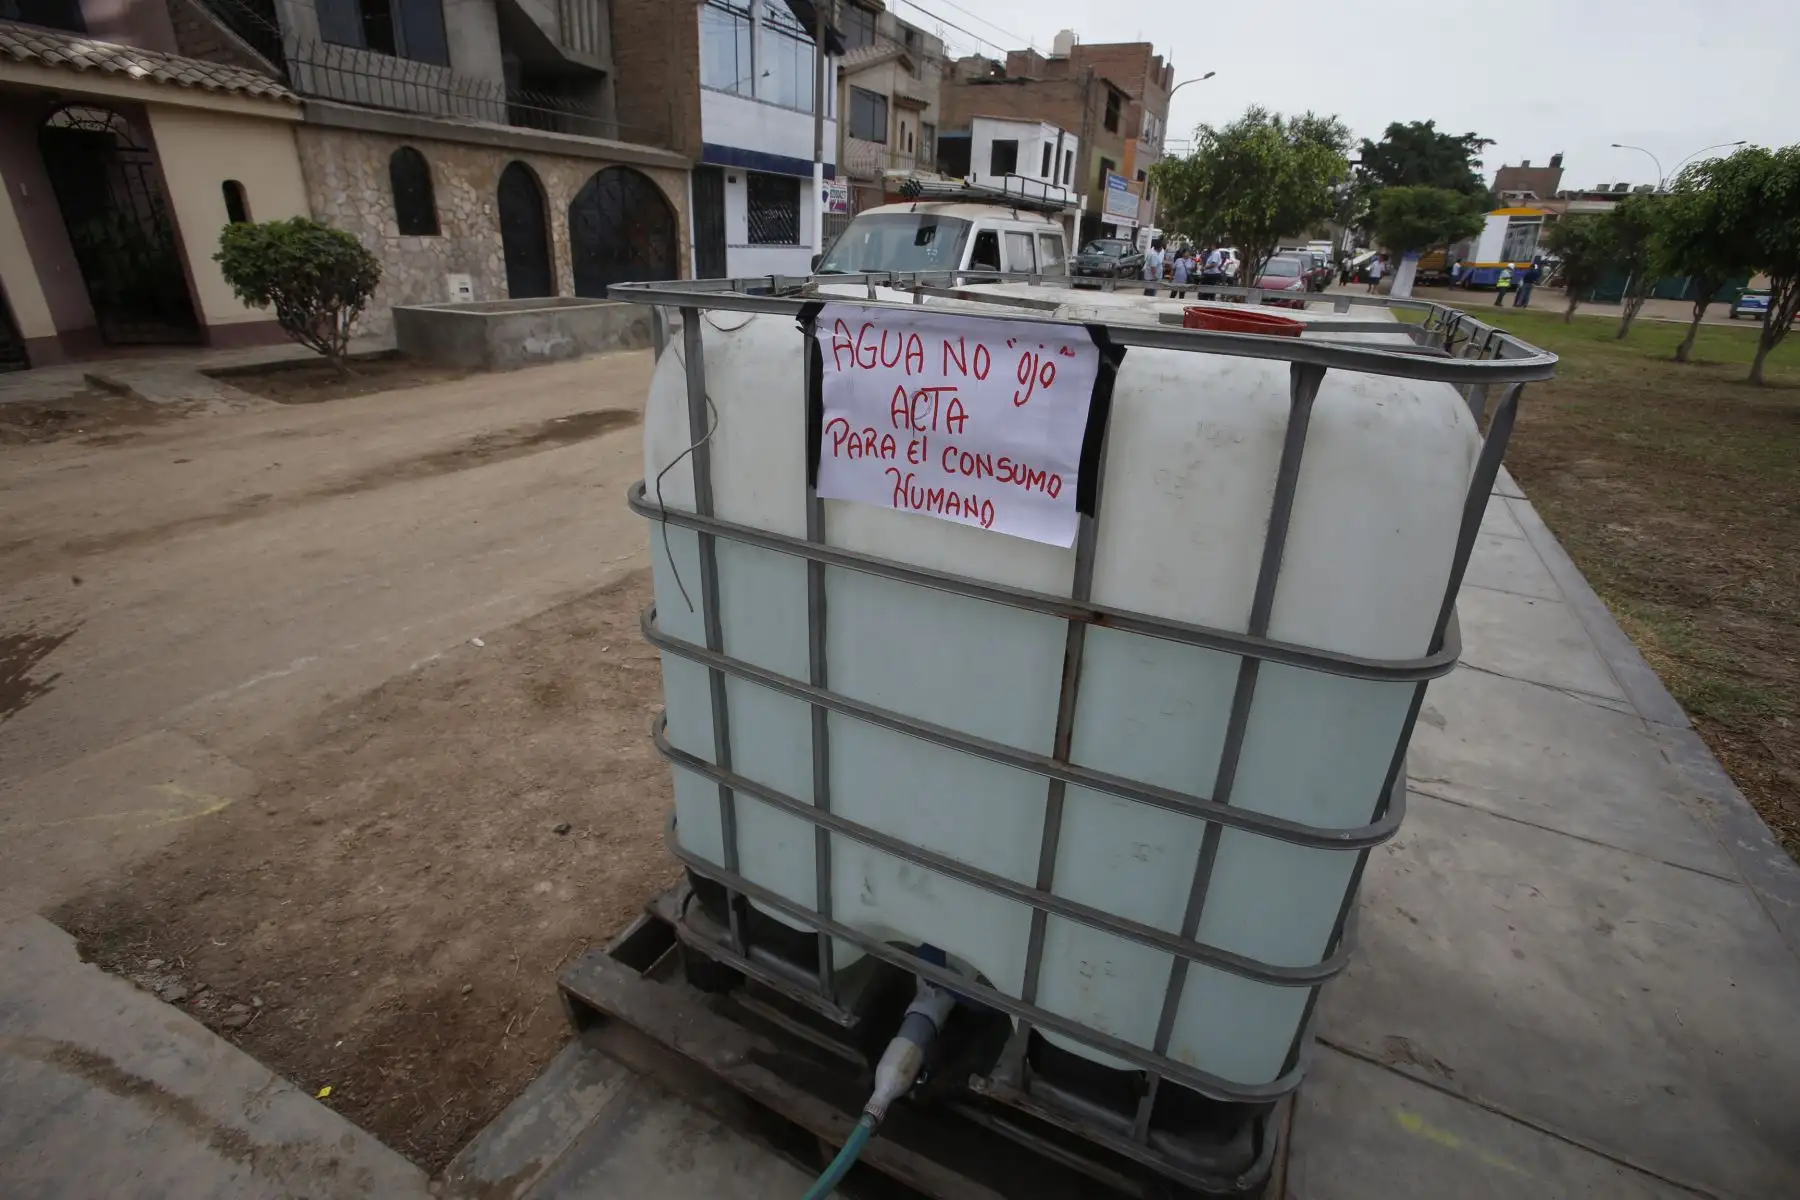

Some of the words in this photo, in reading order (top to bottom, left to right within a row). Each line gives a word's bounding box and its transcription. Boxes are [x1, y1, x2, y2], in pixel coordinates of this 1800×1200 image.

[832, 318, 924, 376] AGUA
[943, 336, 991, 381] NO
[891, 384, 969, 435] ACTA
[825, 417, 896, 459] PARA
[942, 446, 1062, 499] CONSUMO
[885, 467, 995, 529] HUMANO
